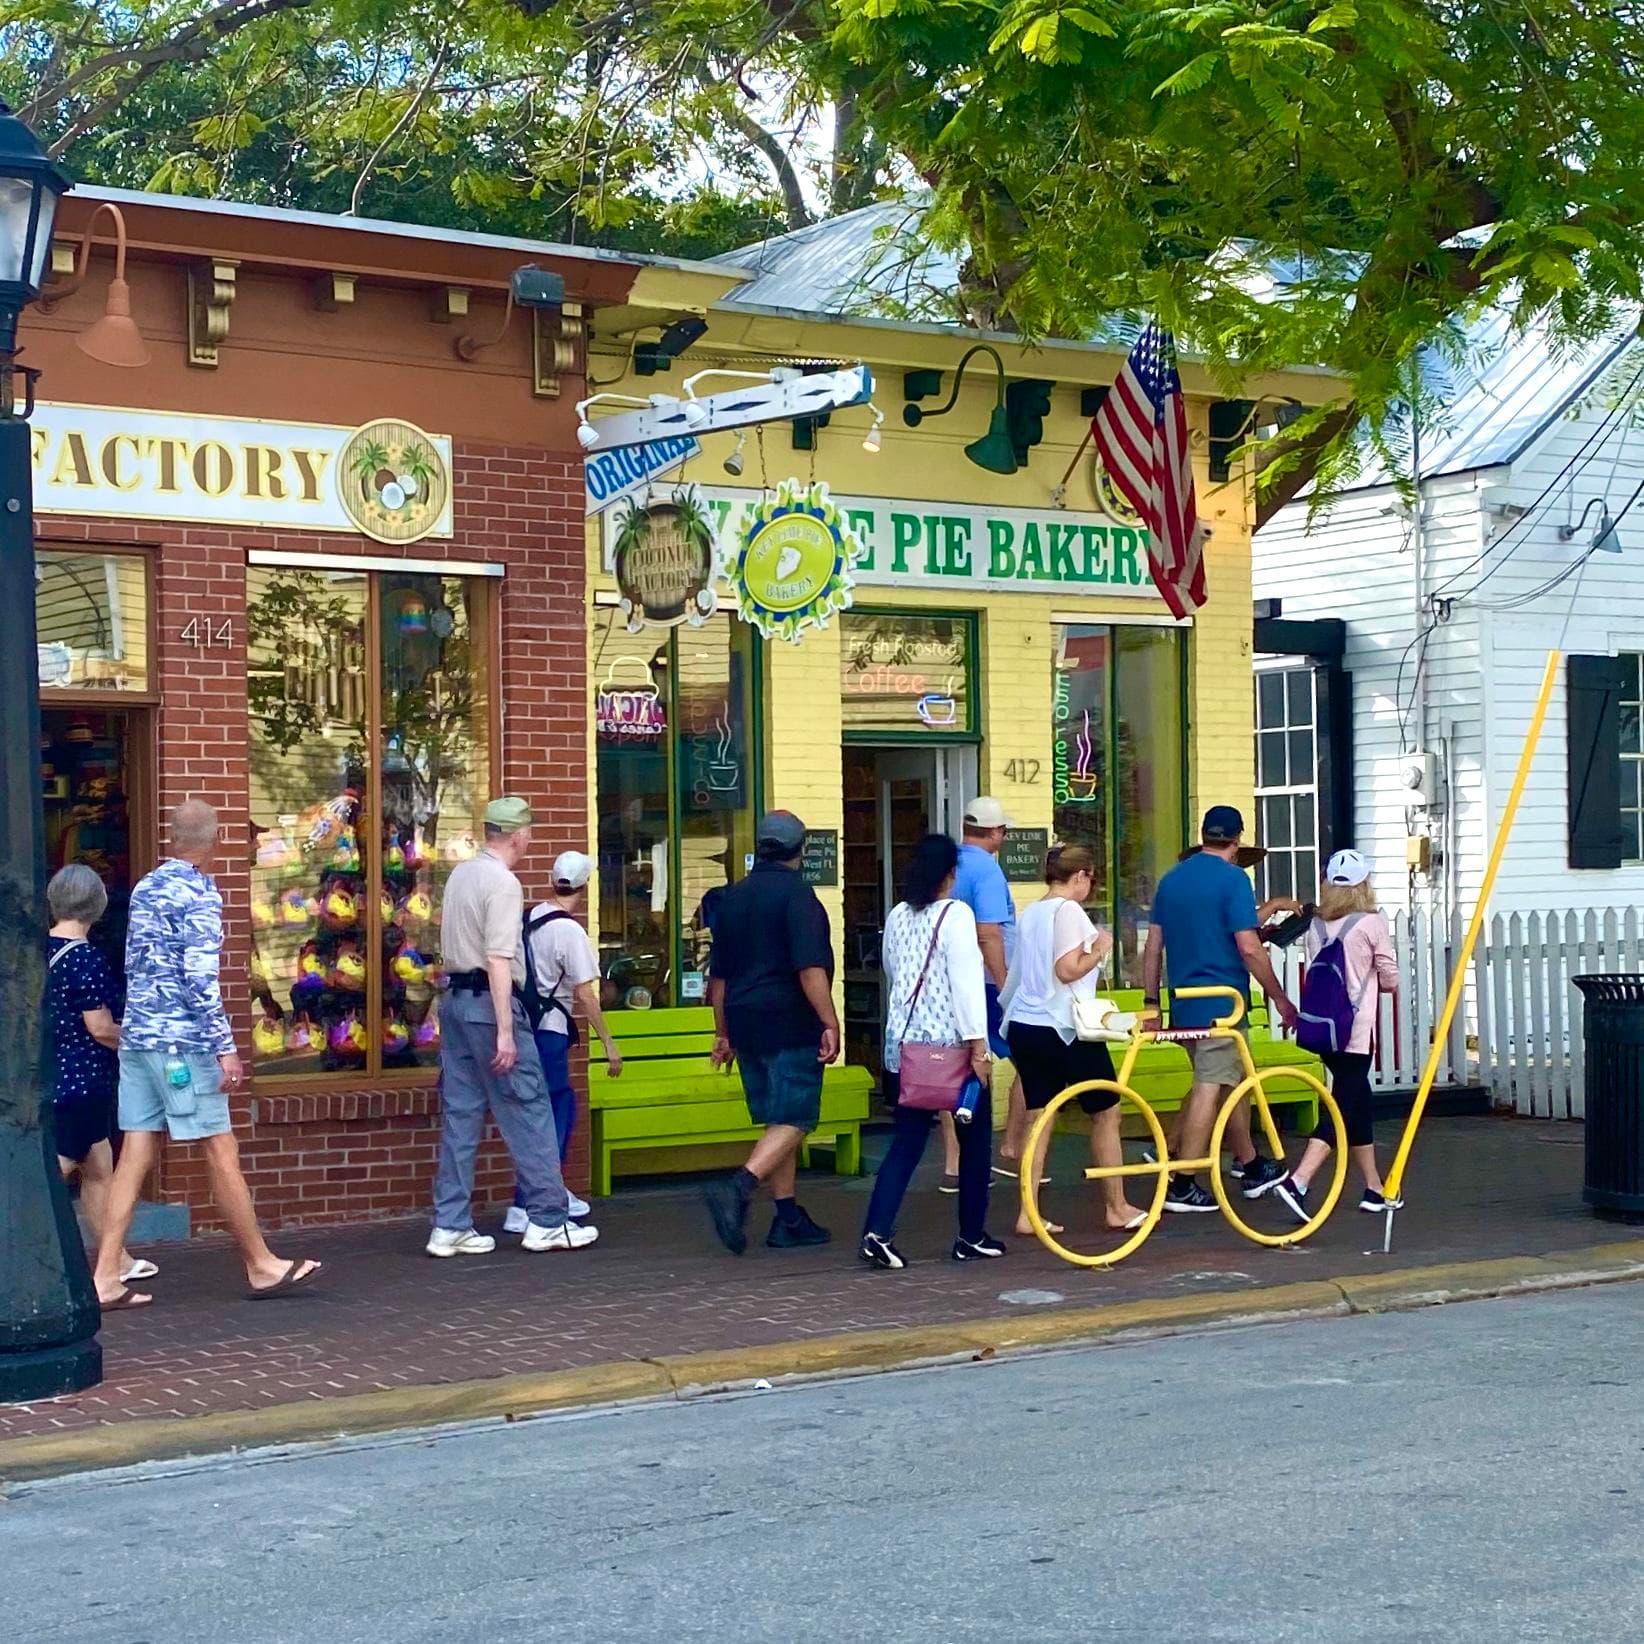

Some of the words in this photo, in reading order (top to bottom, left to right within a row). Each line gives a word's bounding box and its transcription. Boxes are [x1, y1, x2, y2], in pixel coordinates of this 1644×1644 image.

[890, 513, 972, 577] PIE
[766, 577, 814, 600] BAKERY
[181, 617, 235, 650] 414
[849, 636, 889, 655] Fresh
[844, 665, 926, 694] Coffee
[1003, 758, 1041, 785] 412
[1006, 855, 1040, 865] BAKERY
